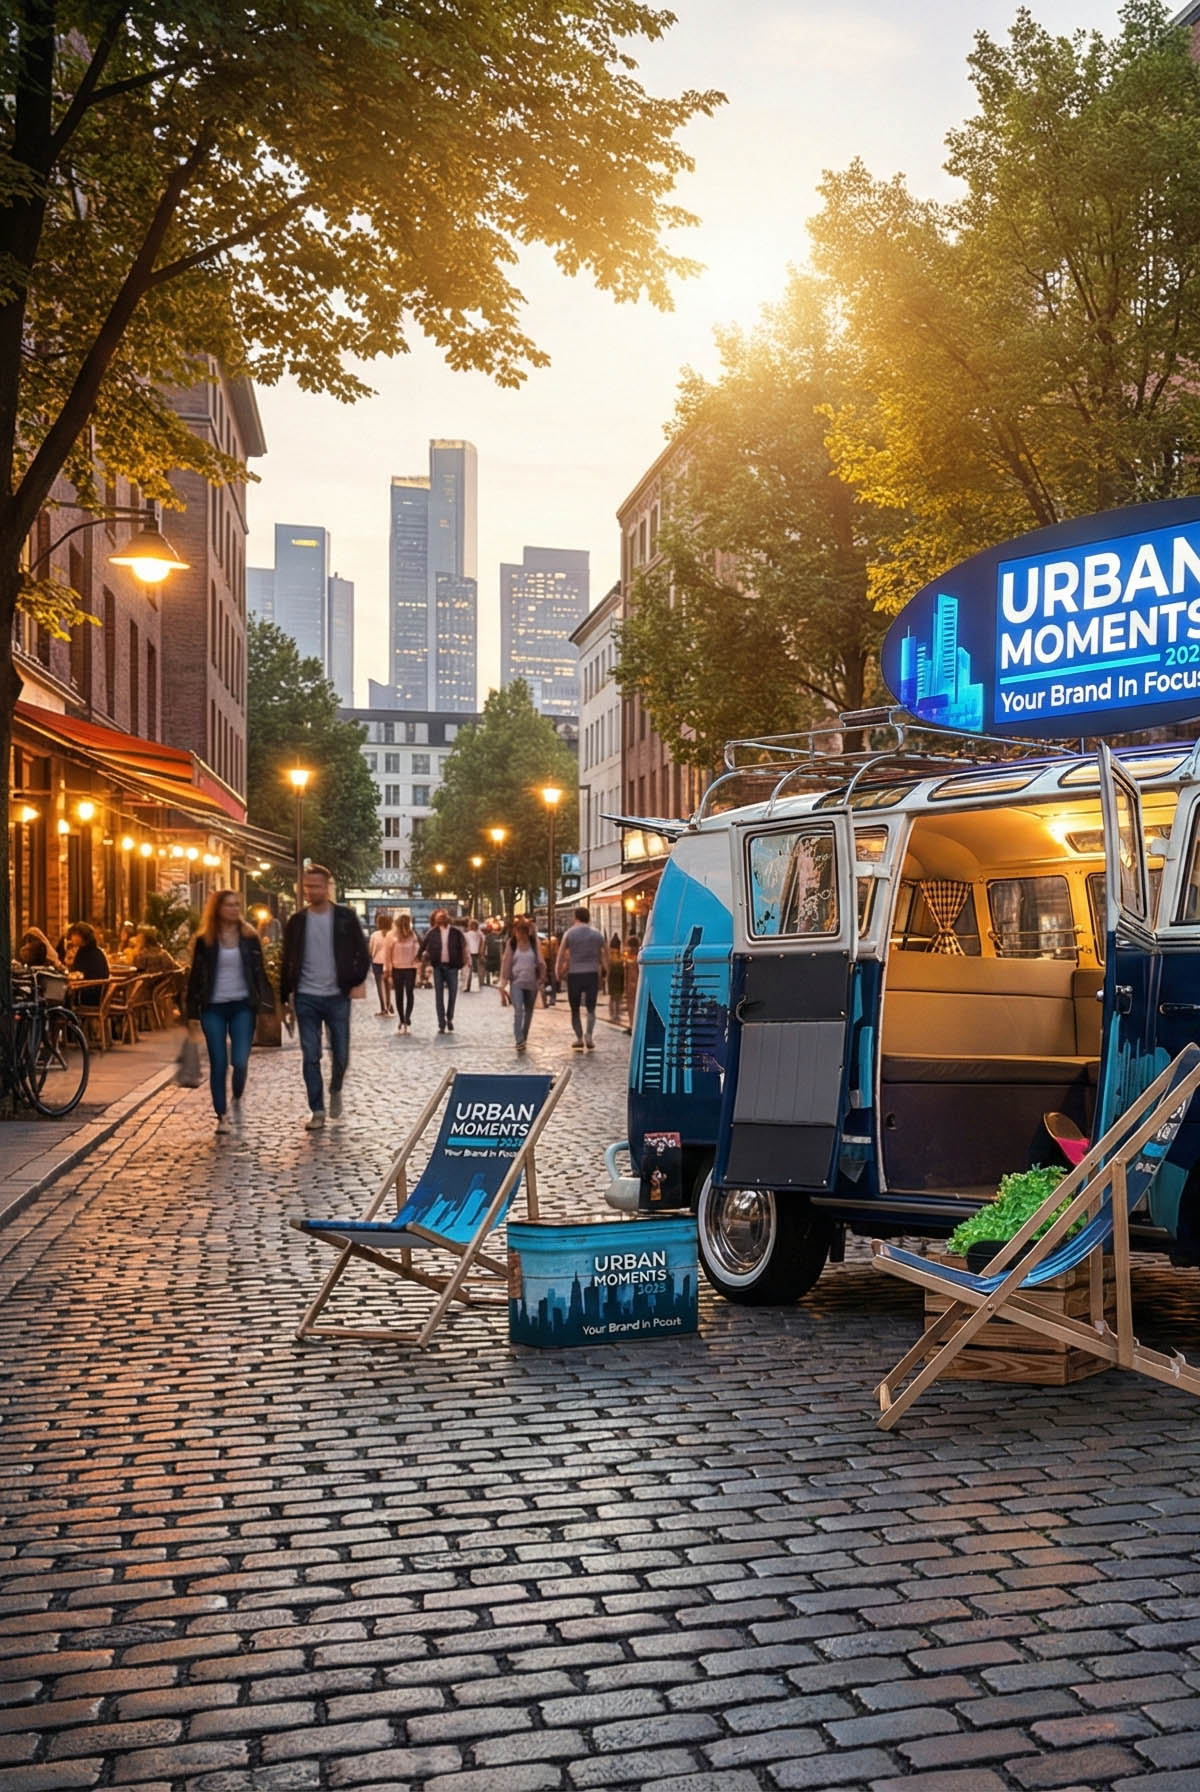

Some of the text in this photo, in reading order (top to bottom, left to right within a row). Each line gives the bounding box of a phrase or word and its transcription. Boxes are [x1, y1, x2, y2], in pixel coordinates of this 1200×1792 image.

[1001, 690, 1046, 713] Your
[1050, 677, 1112, 707] Brand
[456, 1103, 535, 1121] URBAN
[450, 1122, 529, 1136] MOMENTS
[594, 1250, 666, 1272] URBAN
[594, 1269, 667, 1287] MOMENTS
[583, 1325, 606, 1335] Your
[608, 1320, 640, 1333] Brand
